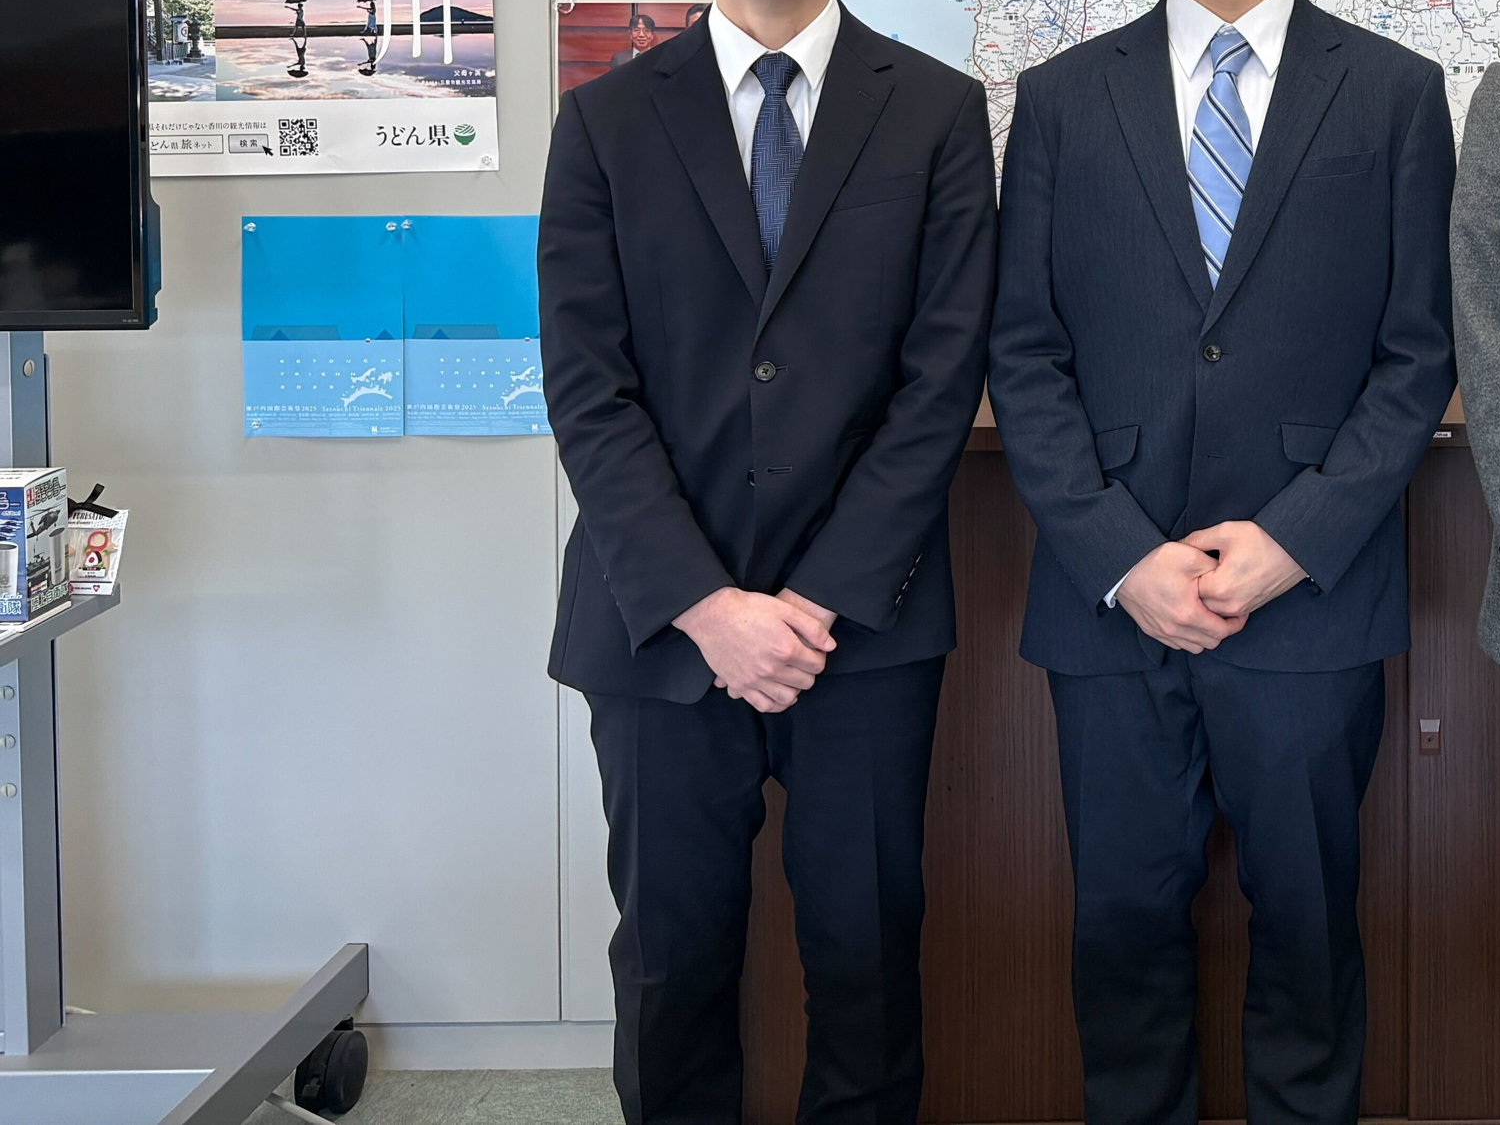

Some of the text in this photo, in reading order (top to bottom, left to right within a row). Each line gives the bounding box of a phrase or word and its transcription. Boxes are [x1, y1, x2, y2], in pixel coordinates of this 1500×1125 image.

[1452, 65, 1485, 73] 香川県
[375, 124, 450, 148] うどん県
[240, 139, 258, 148] 検索
